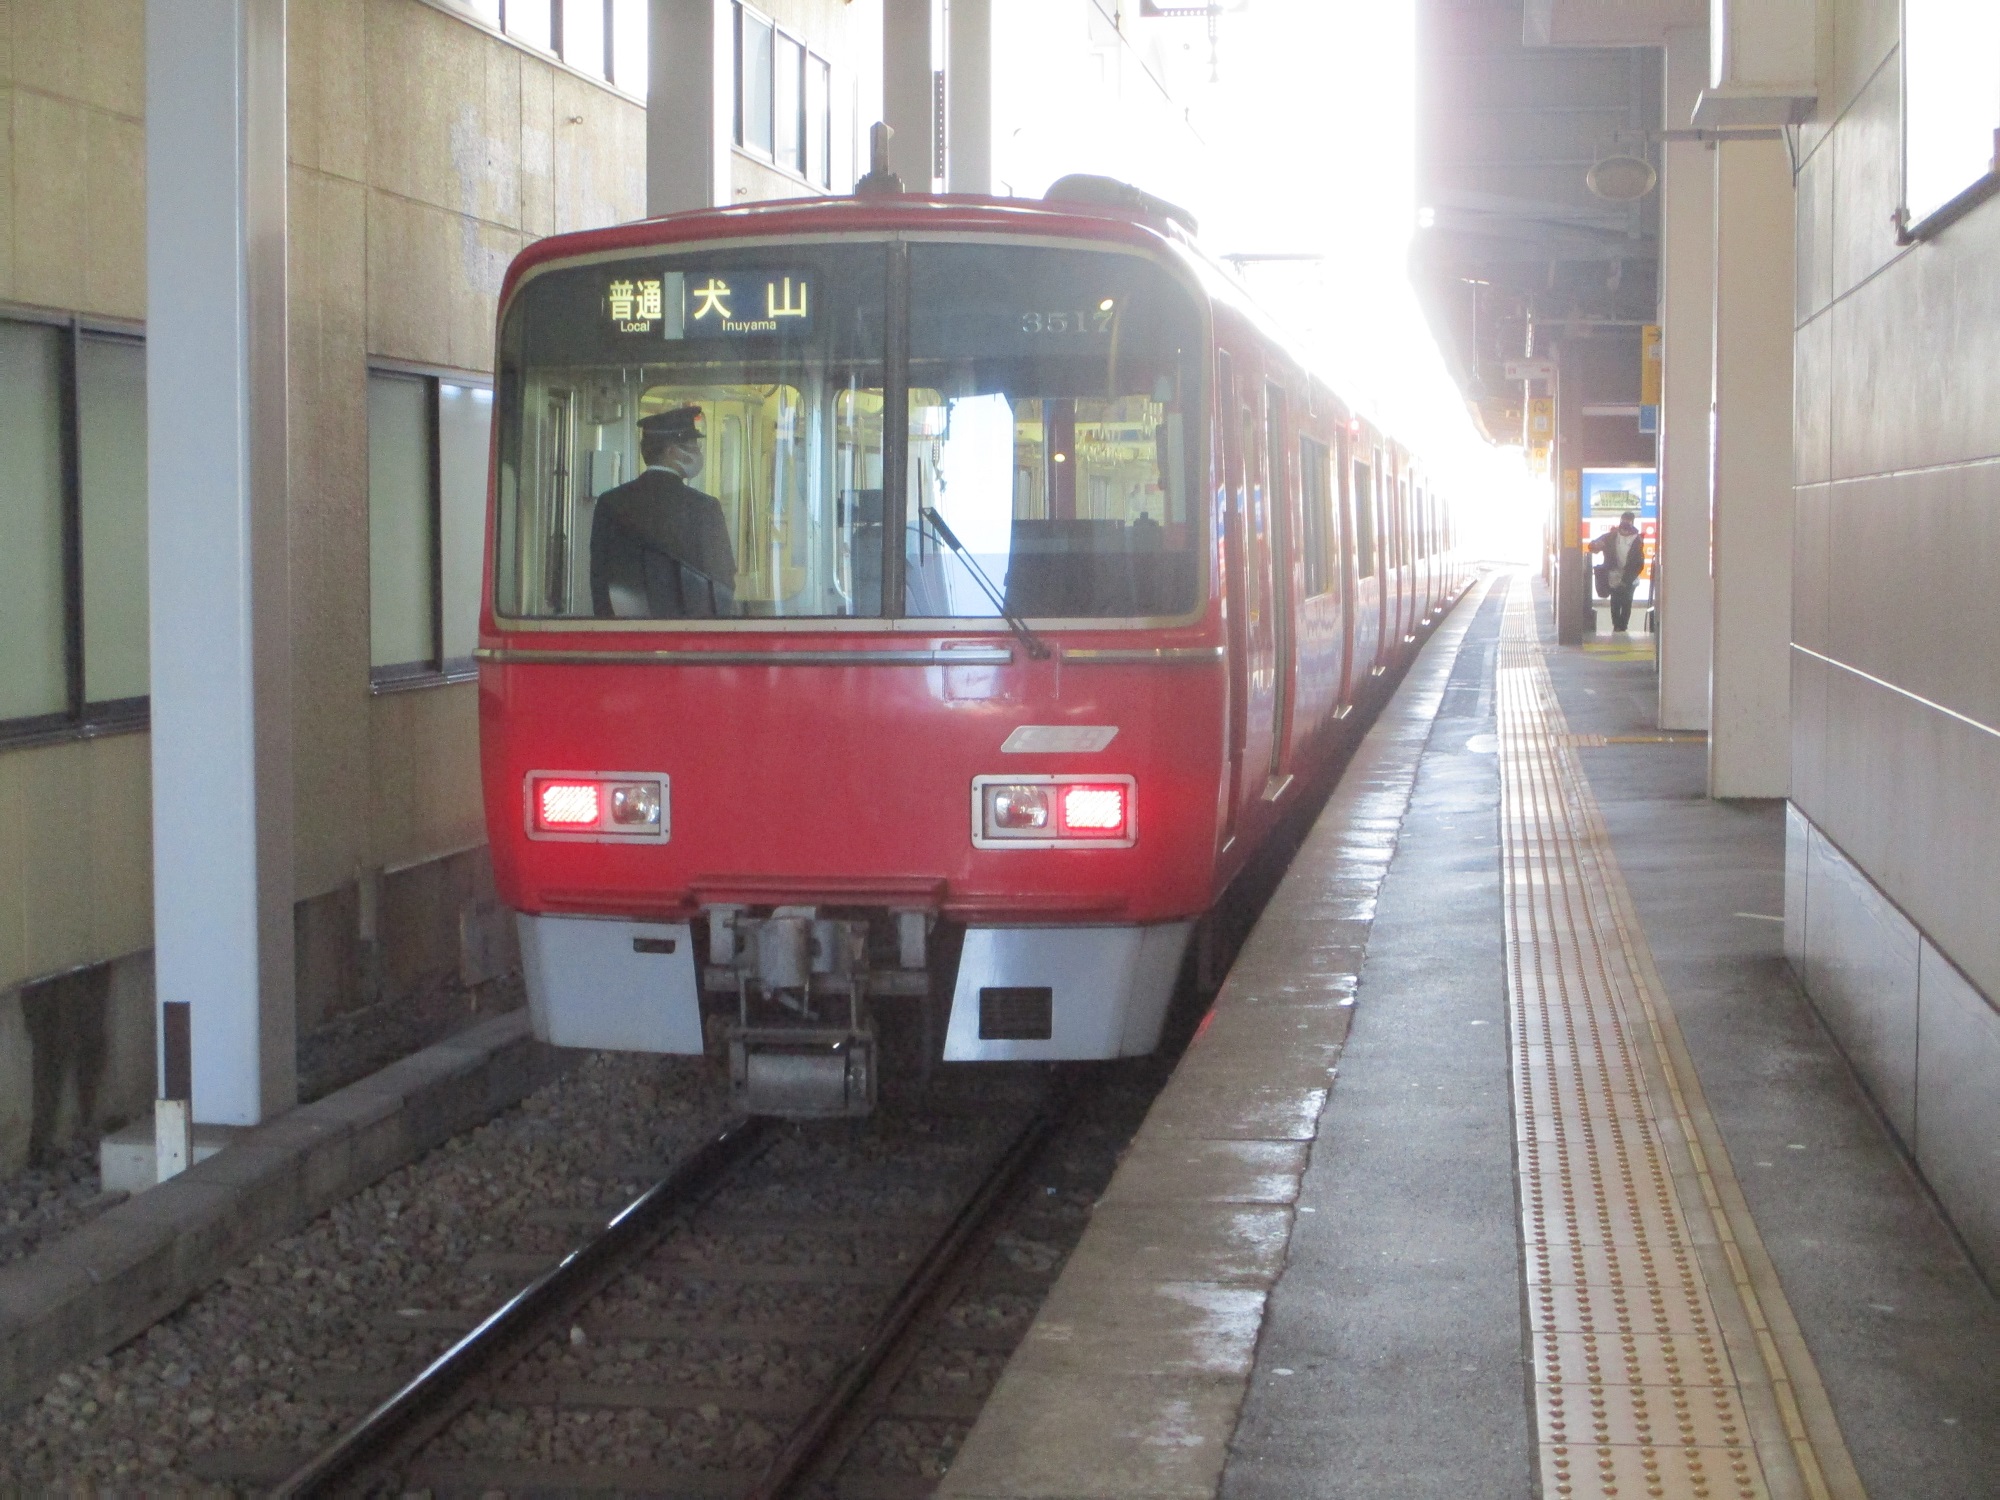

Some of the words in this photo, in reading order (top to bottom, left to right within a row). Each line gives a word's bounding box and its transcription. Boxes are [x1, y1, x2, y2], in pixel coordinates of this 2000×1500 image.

[609, 280, 662, 320] 普通
[694, 277, 807, 319] 犬山
[620, 320, 650, 333] Local
[722, 319, 777, 333] Inuyama
[1022, 311, 1114, 333] 3517
